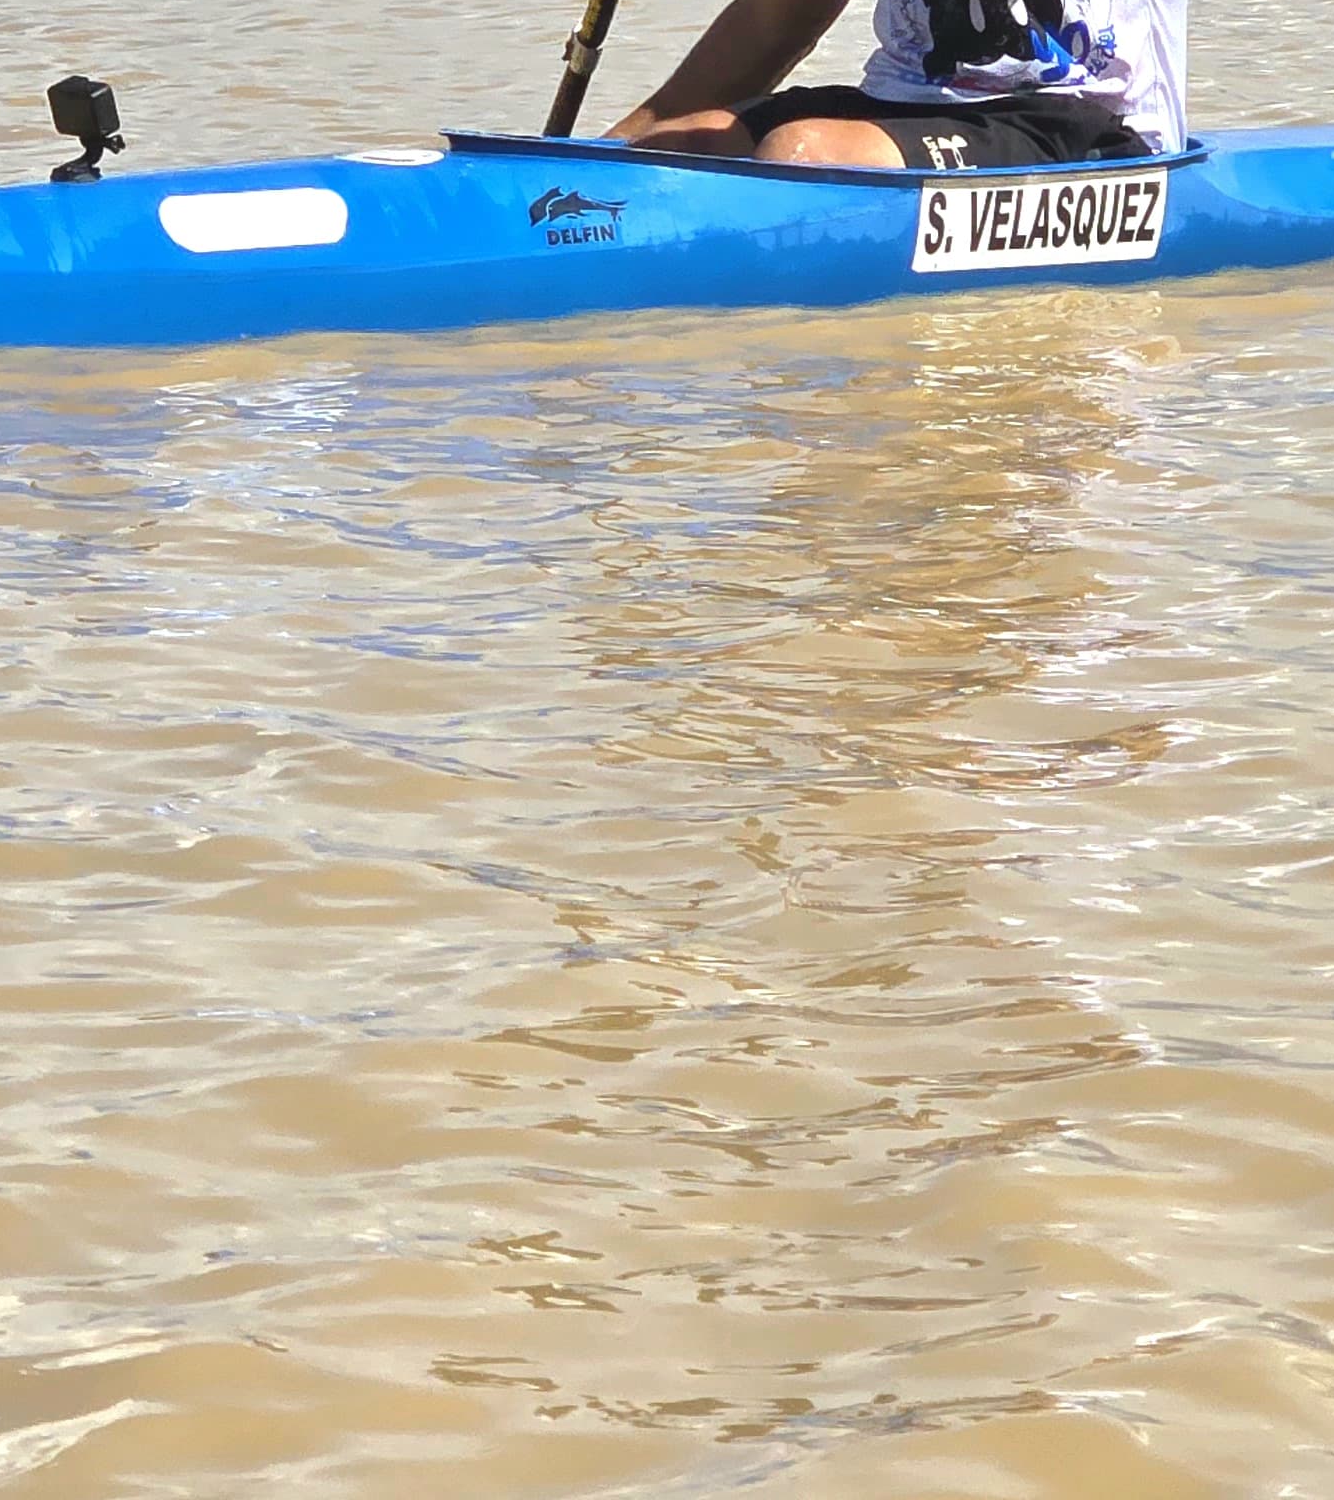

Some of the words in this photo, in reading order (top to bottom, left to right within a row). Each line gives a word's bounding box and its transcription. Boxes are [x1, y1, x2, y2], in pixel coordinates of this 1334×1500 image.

[547, 224, 614, 246] DELFIN
[924, 191, 953, 255] S.
[970, 181, 1161, 253] VELASQUEZ
